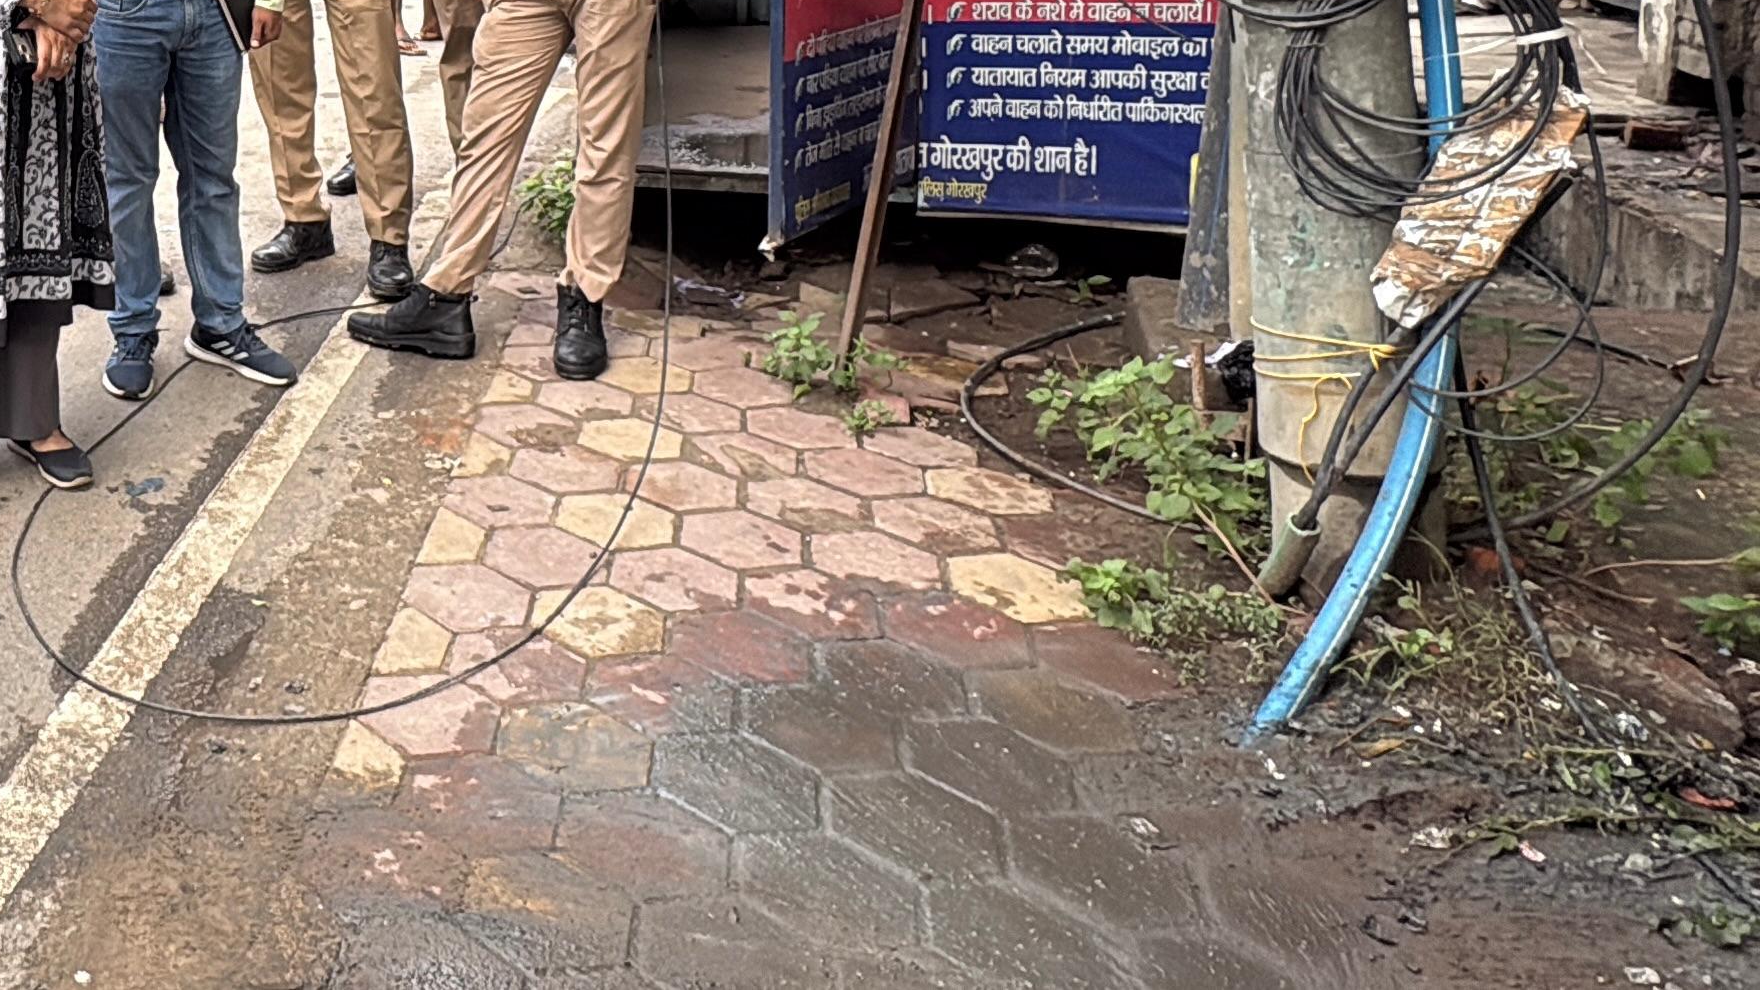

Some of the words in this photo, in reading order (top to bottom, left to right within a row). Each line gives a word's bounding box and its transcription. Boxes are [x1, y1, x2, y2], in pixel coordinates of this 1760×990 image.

[1087, 2, 1131, 22] वाहन
[971, 34, 1014, 55] वाहन
[1015, 29, 1063, 55] चलाते
[1065, 35, 1109, 55] समय
[1182, 37, 1208, 57] का
[971, 67, 1037, 87] यातायात
[1040, 61, 1087, 88] नियम
[1089, 63, 1148, 90] आपकी
[1150, 70, 1198, 98] सुरक्षा
[968, 93, 1003, 118] अपने
[1005, 99, 1041, 119] वाहन
[1043, 95, 1064, 120] को
[930, 135, 1004, 181] गोरखपुर
[1006, 135, 1031, 172] की
[1034, 146, 1072, 174] शान
